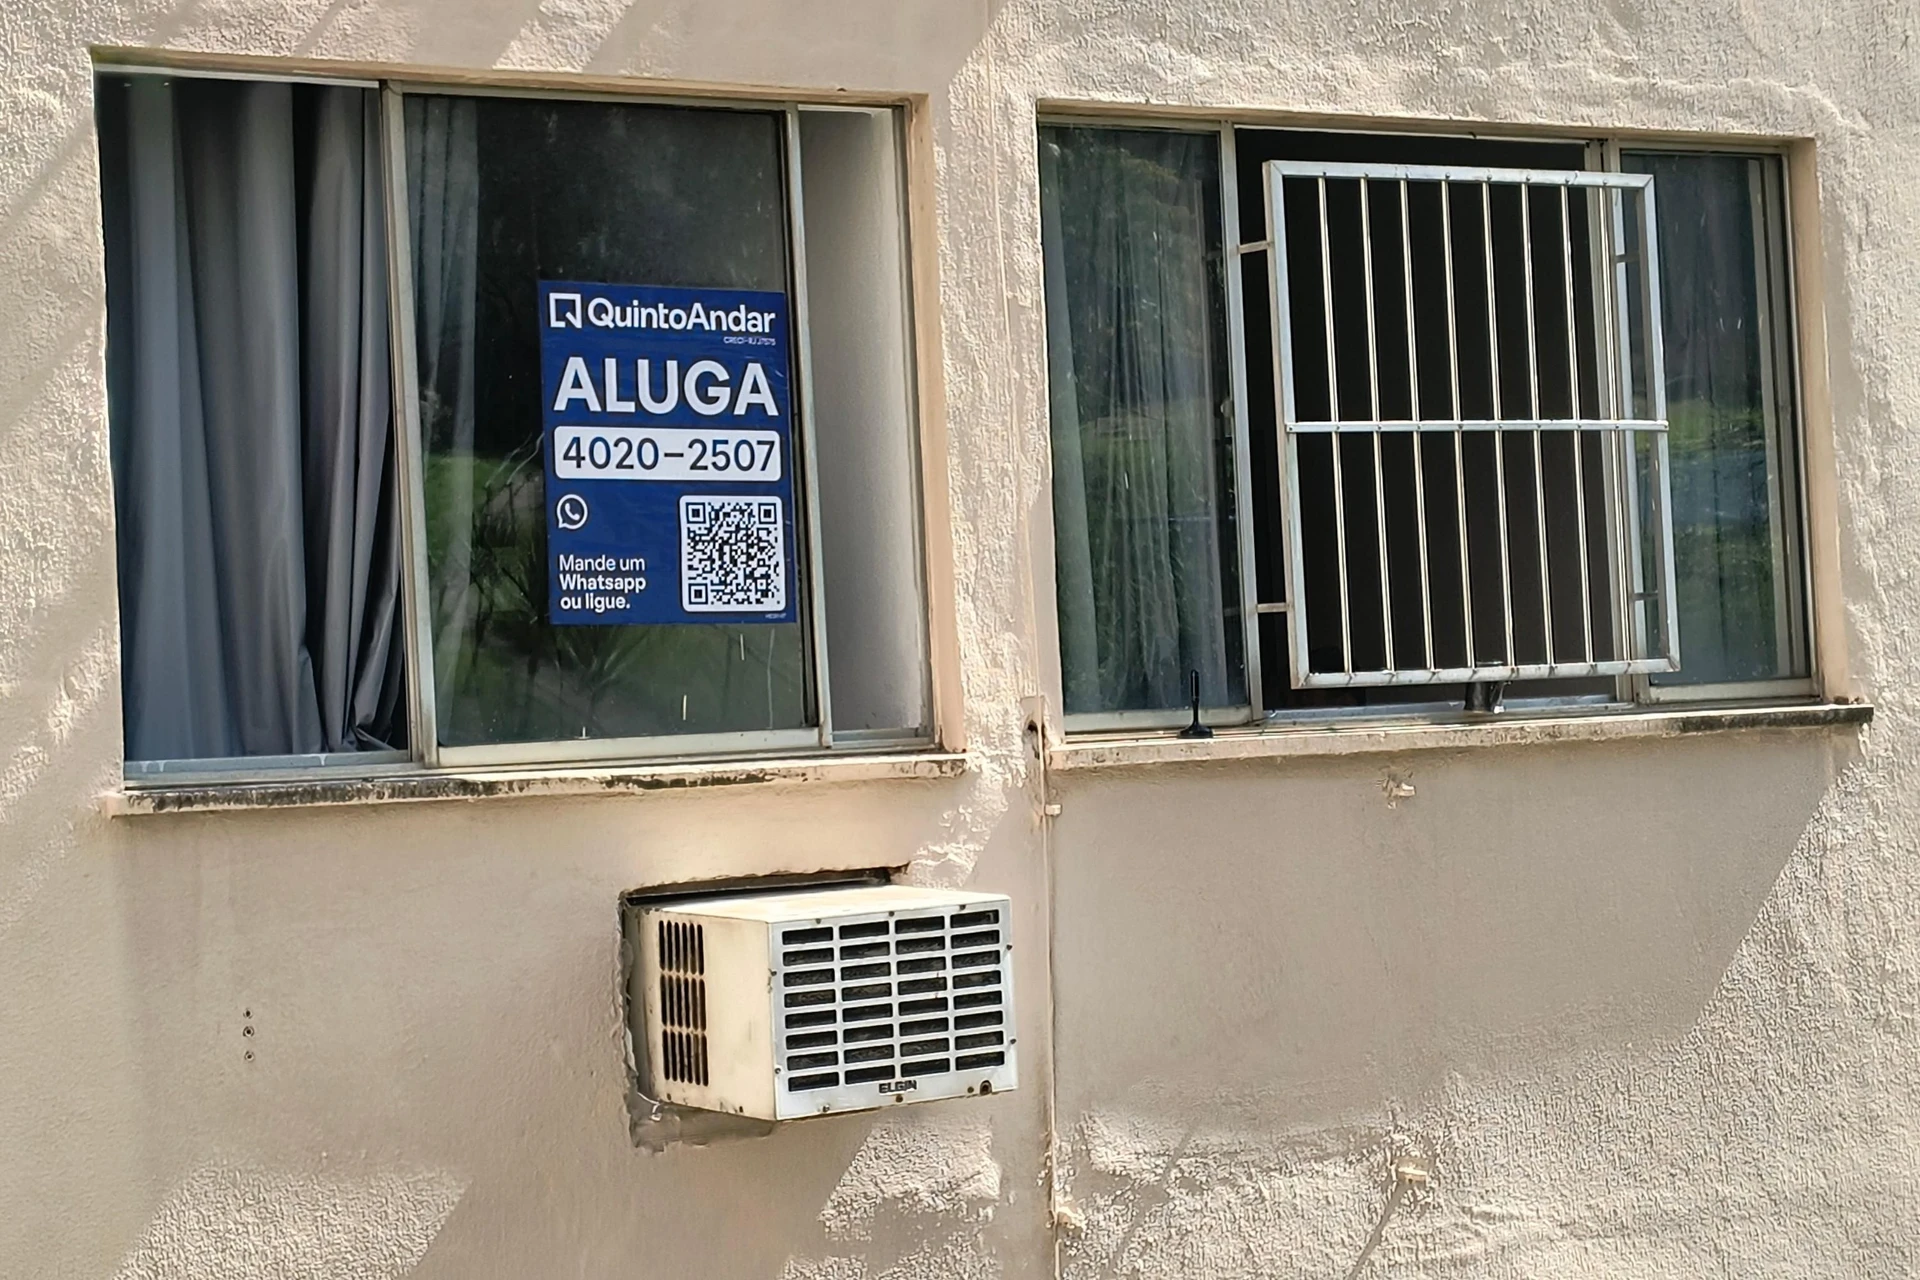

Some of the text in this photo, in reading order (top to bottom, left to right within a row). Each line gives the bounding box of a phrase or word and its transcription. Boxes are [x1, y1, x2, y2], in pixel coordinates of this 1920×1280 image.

[587, 297, 776, 333] QuintoAndar
[553, 356, 779, 416] ALUGA
[563, 436, 775, 472] 4020-2507
[559, 554, 645, 571] Mande um
[559, 573, 646, 593] Whatsapp
[560, 592, 631, 613] ou ligue.
[879, 1080, 917, 1093] ELGIN
